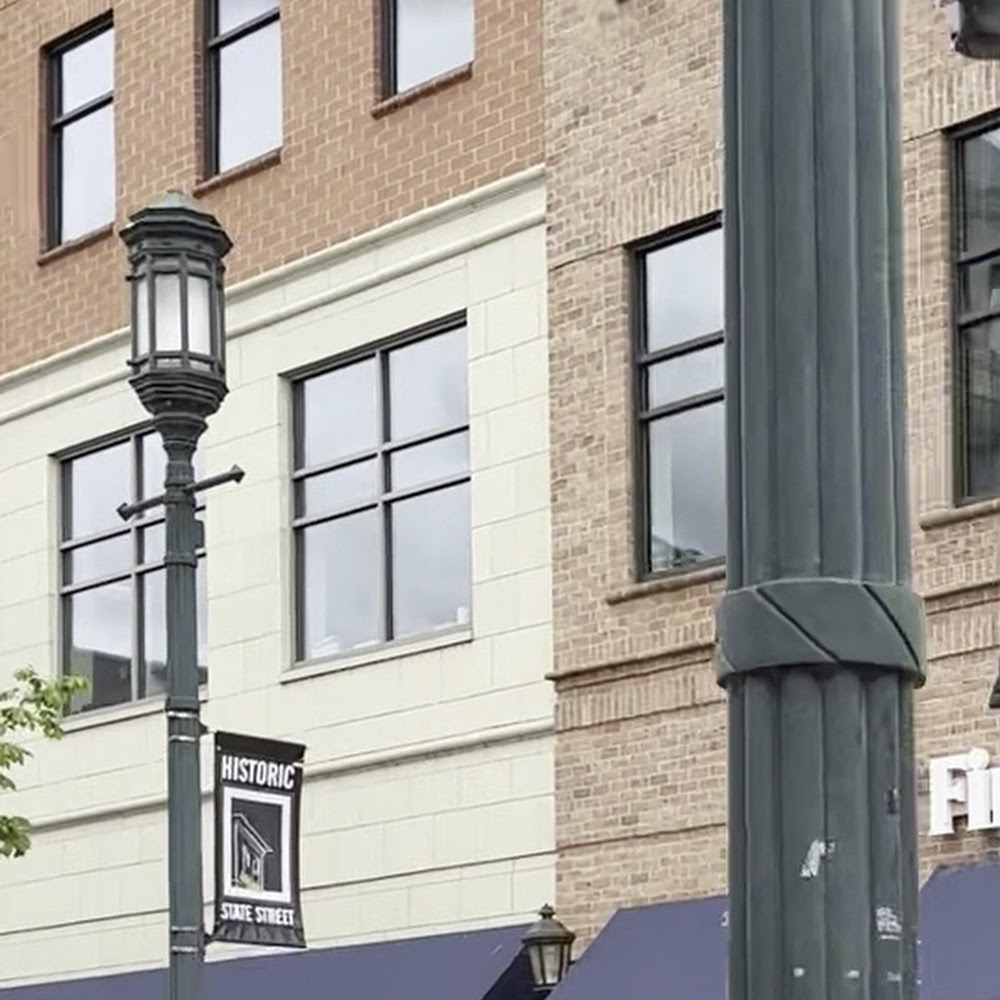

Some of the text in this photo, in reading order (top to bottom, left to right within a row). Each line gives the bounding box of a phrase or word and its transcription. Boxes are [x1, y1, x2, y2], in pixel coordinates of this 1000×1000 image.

[221, 754, 295, 789] HISTORIC
[220, 902, 294, 925] STATE STREET
